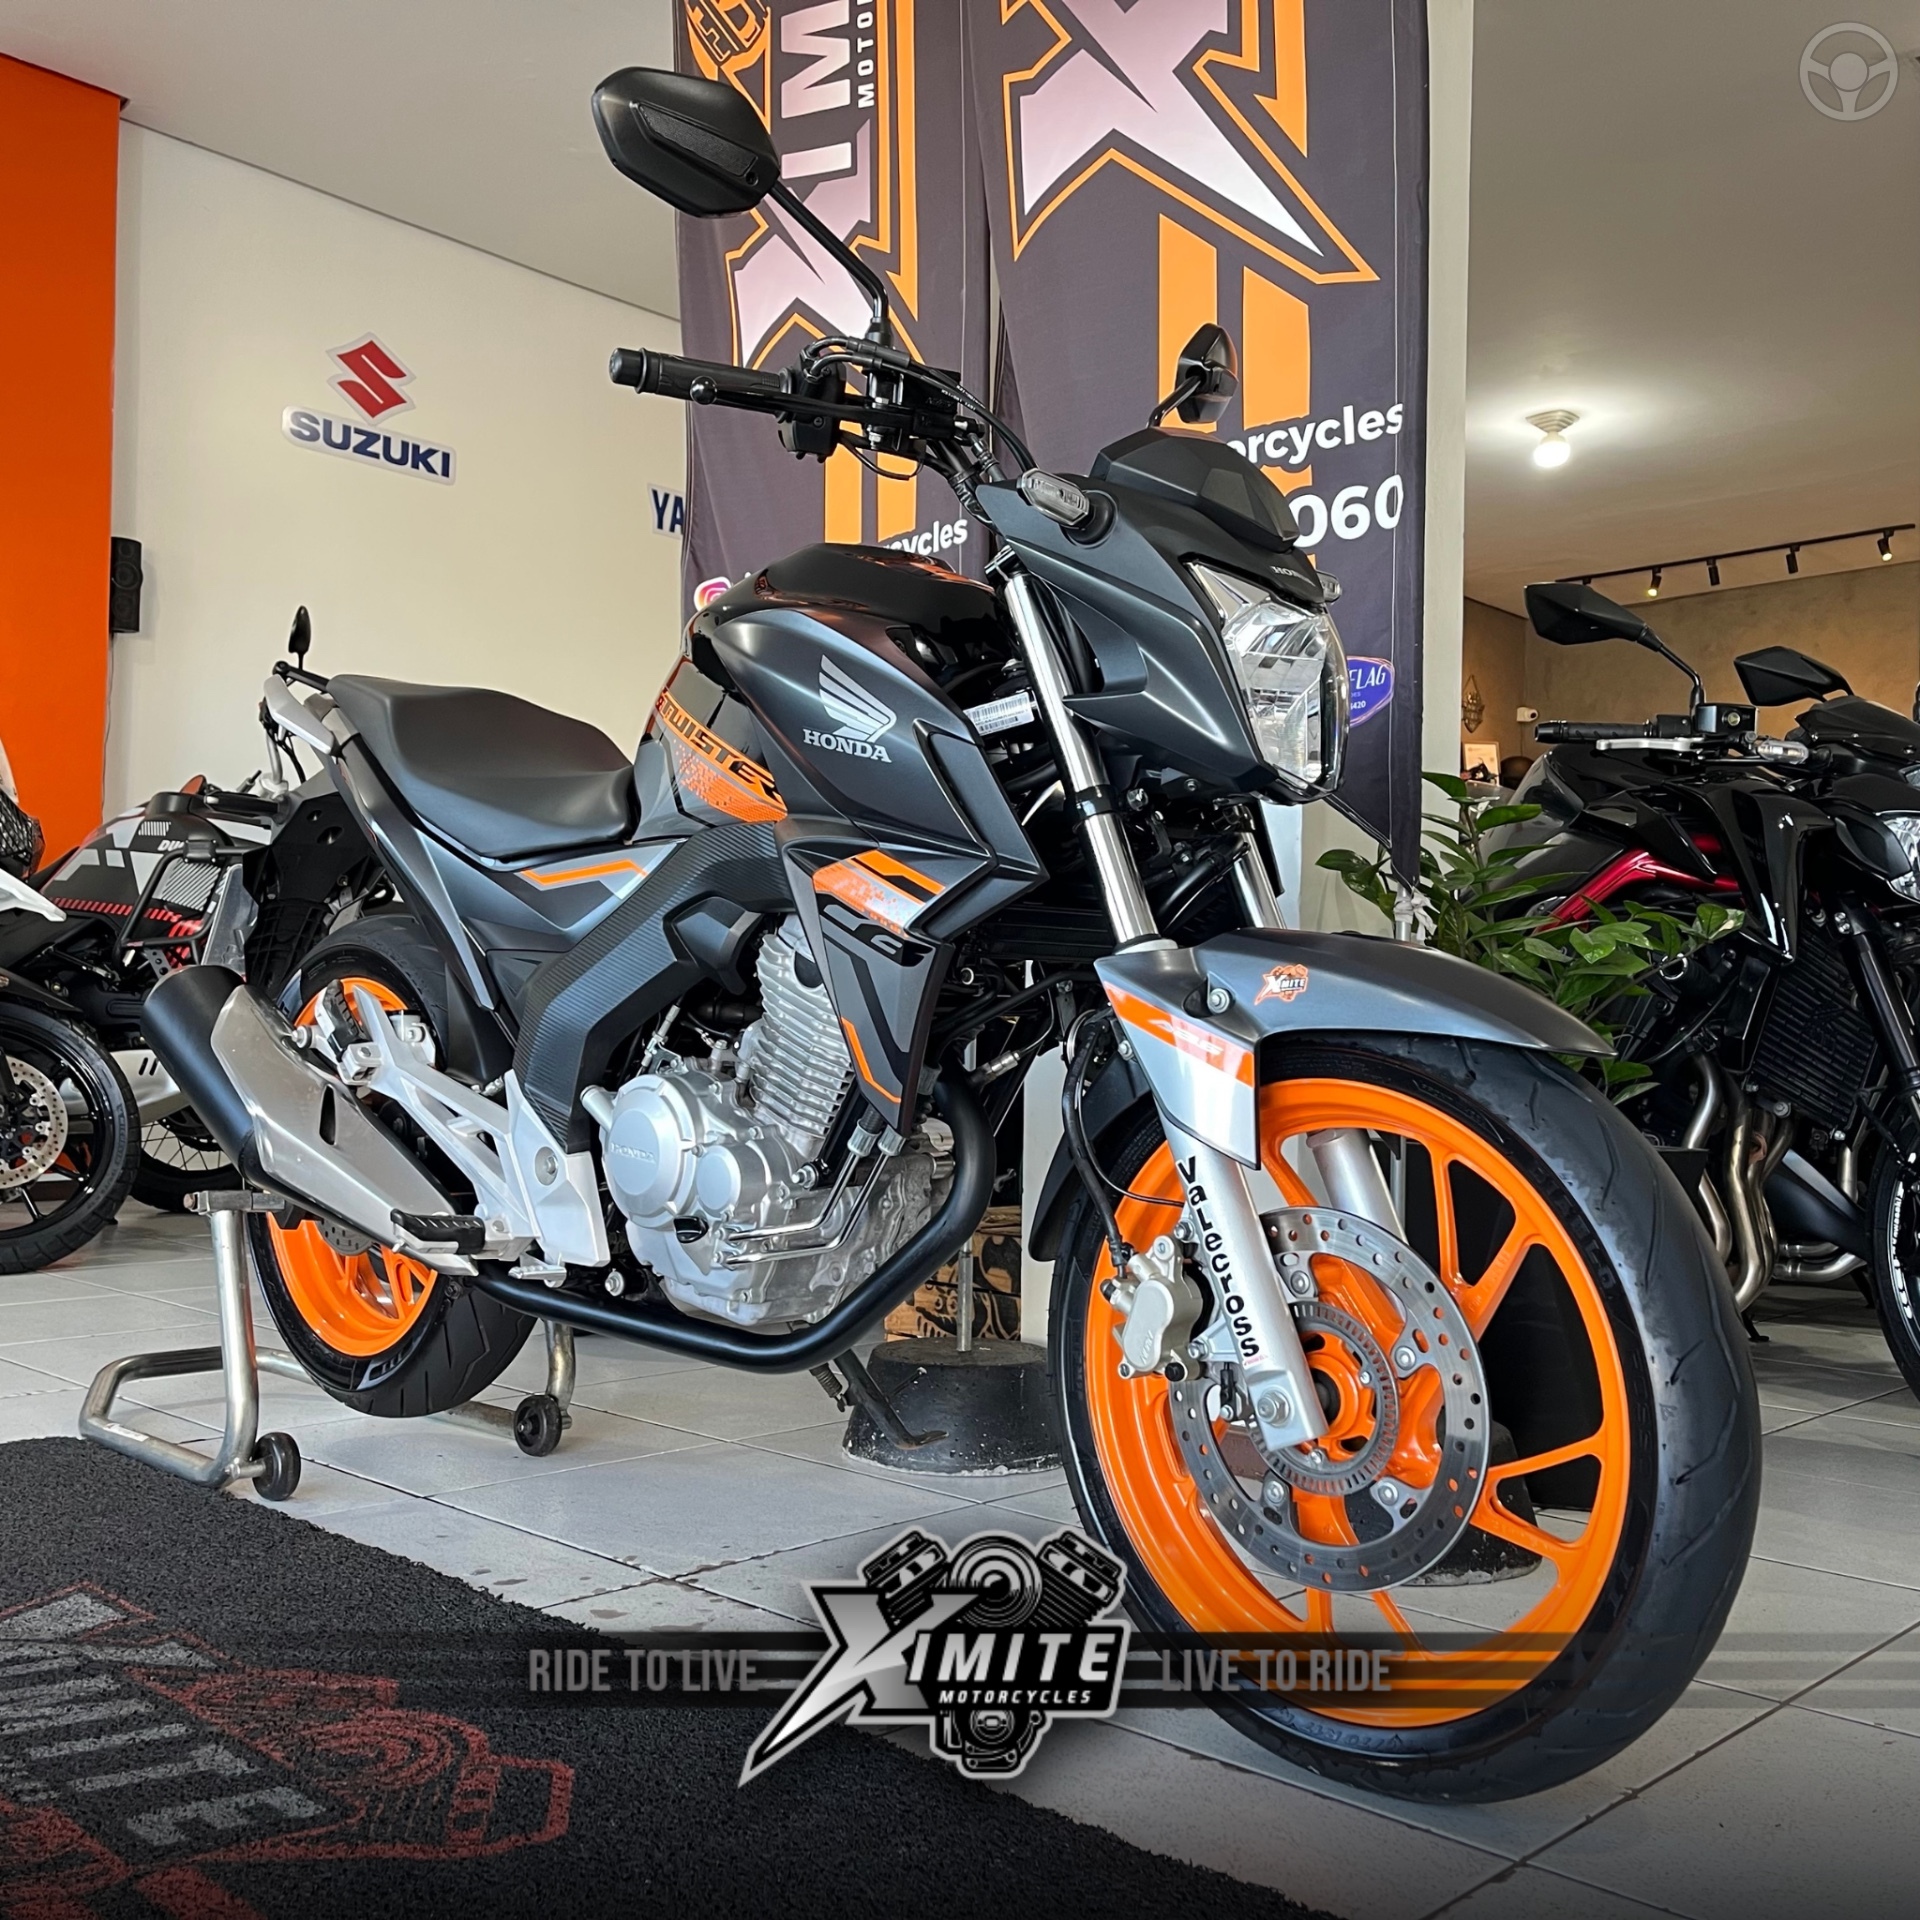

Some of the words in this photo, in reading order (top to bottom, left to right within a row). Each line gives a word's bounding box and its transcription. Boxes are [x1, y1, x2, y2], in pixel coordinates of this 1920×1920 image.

[856, 0, 875, 109] MOTO
[289, 410, 451, 479] SUZUKI
[883, 518, 969, 556] ycles
[802, 728, 893, 764] HONDA
[610, 1141, 658, 1166] HONDA
